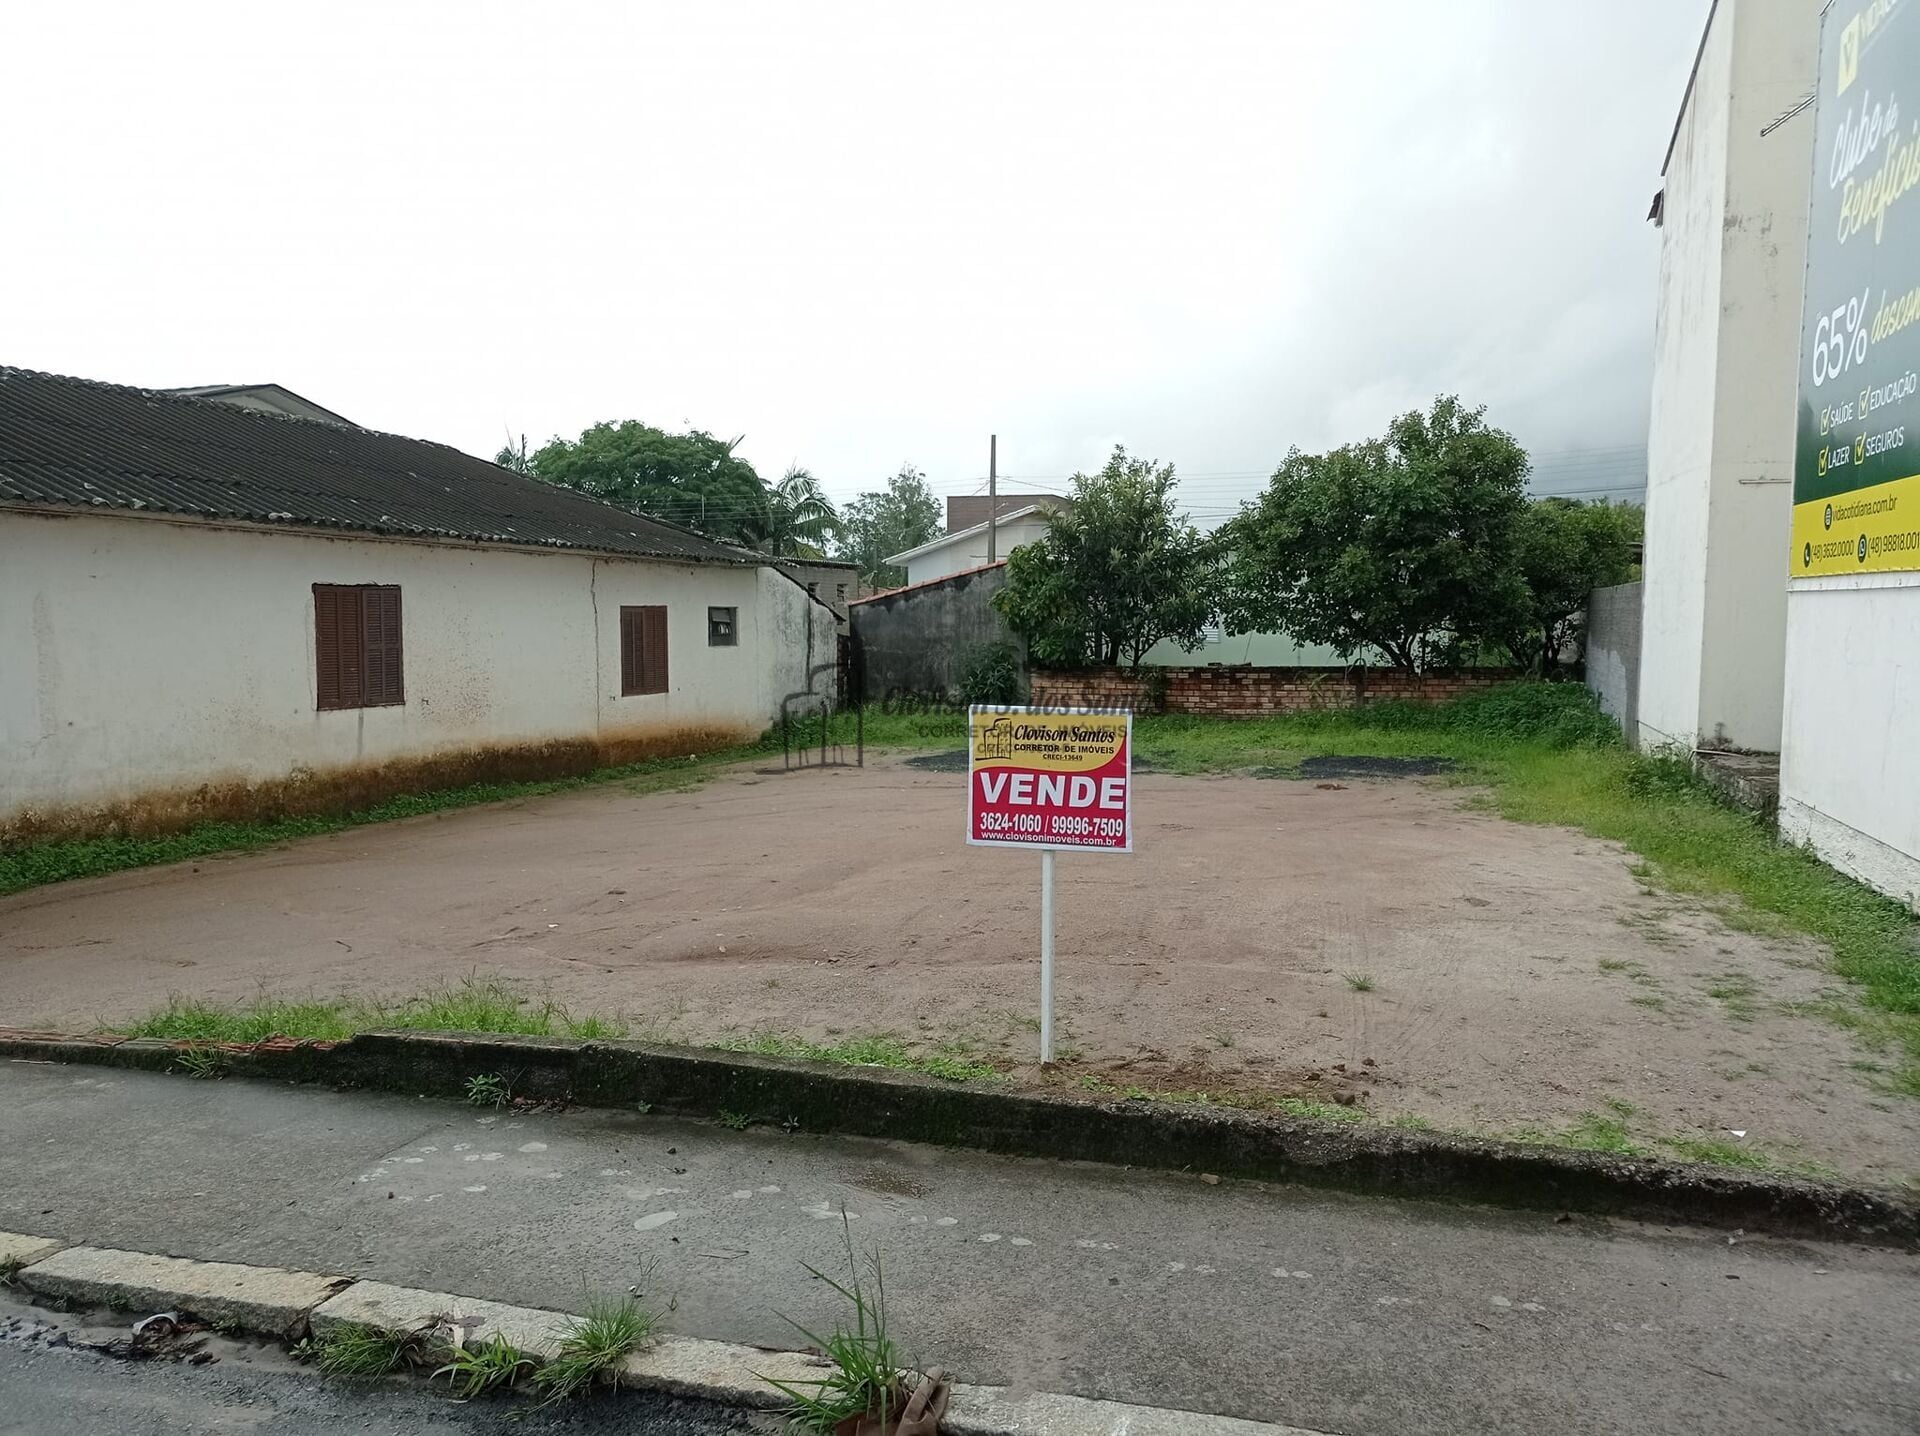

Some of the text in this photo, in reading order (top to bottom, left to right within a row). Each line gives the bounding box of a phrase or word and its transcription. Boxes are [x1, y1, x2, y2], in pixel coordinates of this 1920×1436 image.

[1830, 89, 1883, 189] Clube
[1812, 287, 1869, 387] 65%
[1830, 370, 1917, 428] SAÚDE EDUCAÇÃO
[1827, 426, 1904, 469] LAZER SEGUROS
[1013, 743, 1060, 753] CORRETOR
[1064, 745, 1076, 753] DE
[1078, 744, 1115, 754] IMÓVEIS
[1014, 724, 1116, 744] Clovison Santos
[979, 771, 1126, 810] VENDE
[980, 811, 1042, 832] 3624-1060
[1051, 815, 1124, 837] 99996-7509
[981, 830, 1117, 846] www.clovisonimoveis.com.br
